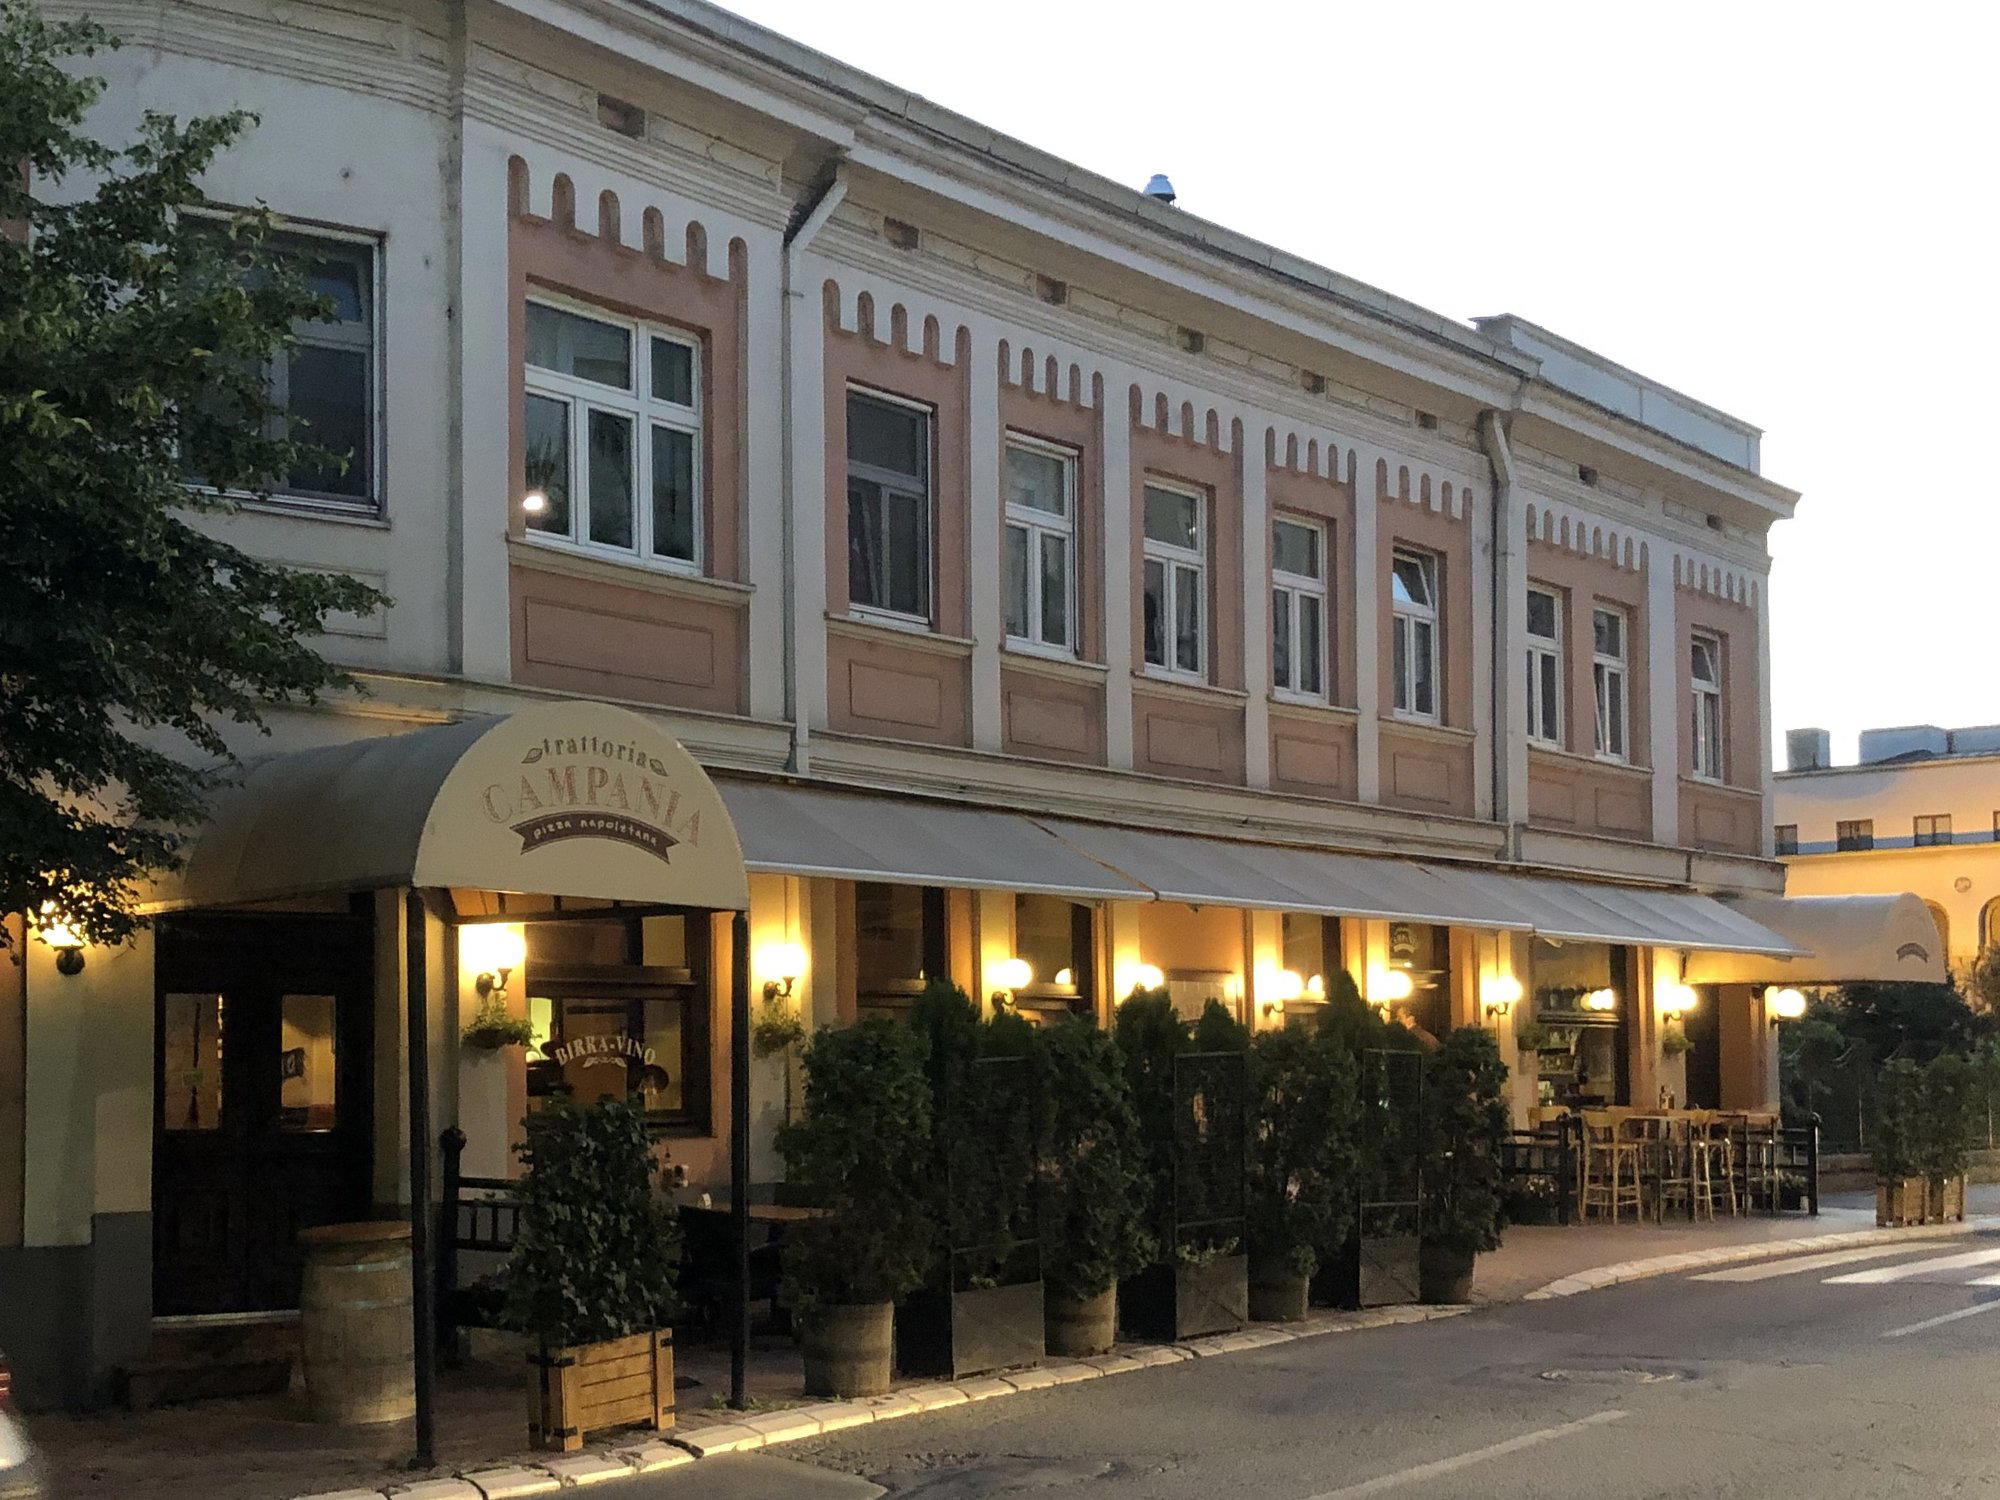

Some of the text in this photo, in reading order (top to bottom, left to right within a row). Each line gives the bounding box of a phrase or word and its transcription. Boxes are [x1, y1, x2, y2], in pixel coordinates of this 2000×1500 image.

[542, 736, 647, 769] trattoria
[481, 764, 701, 848] CAMPANIA
[533, 820, 573, 840] pizza
